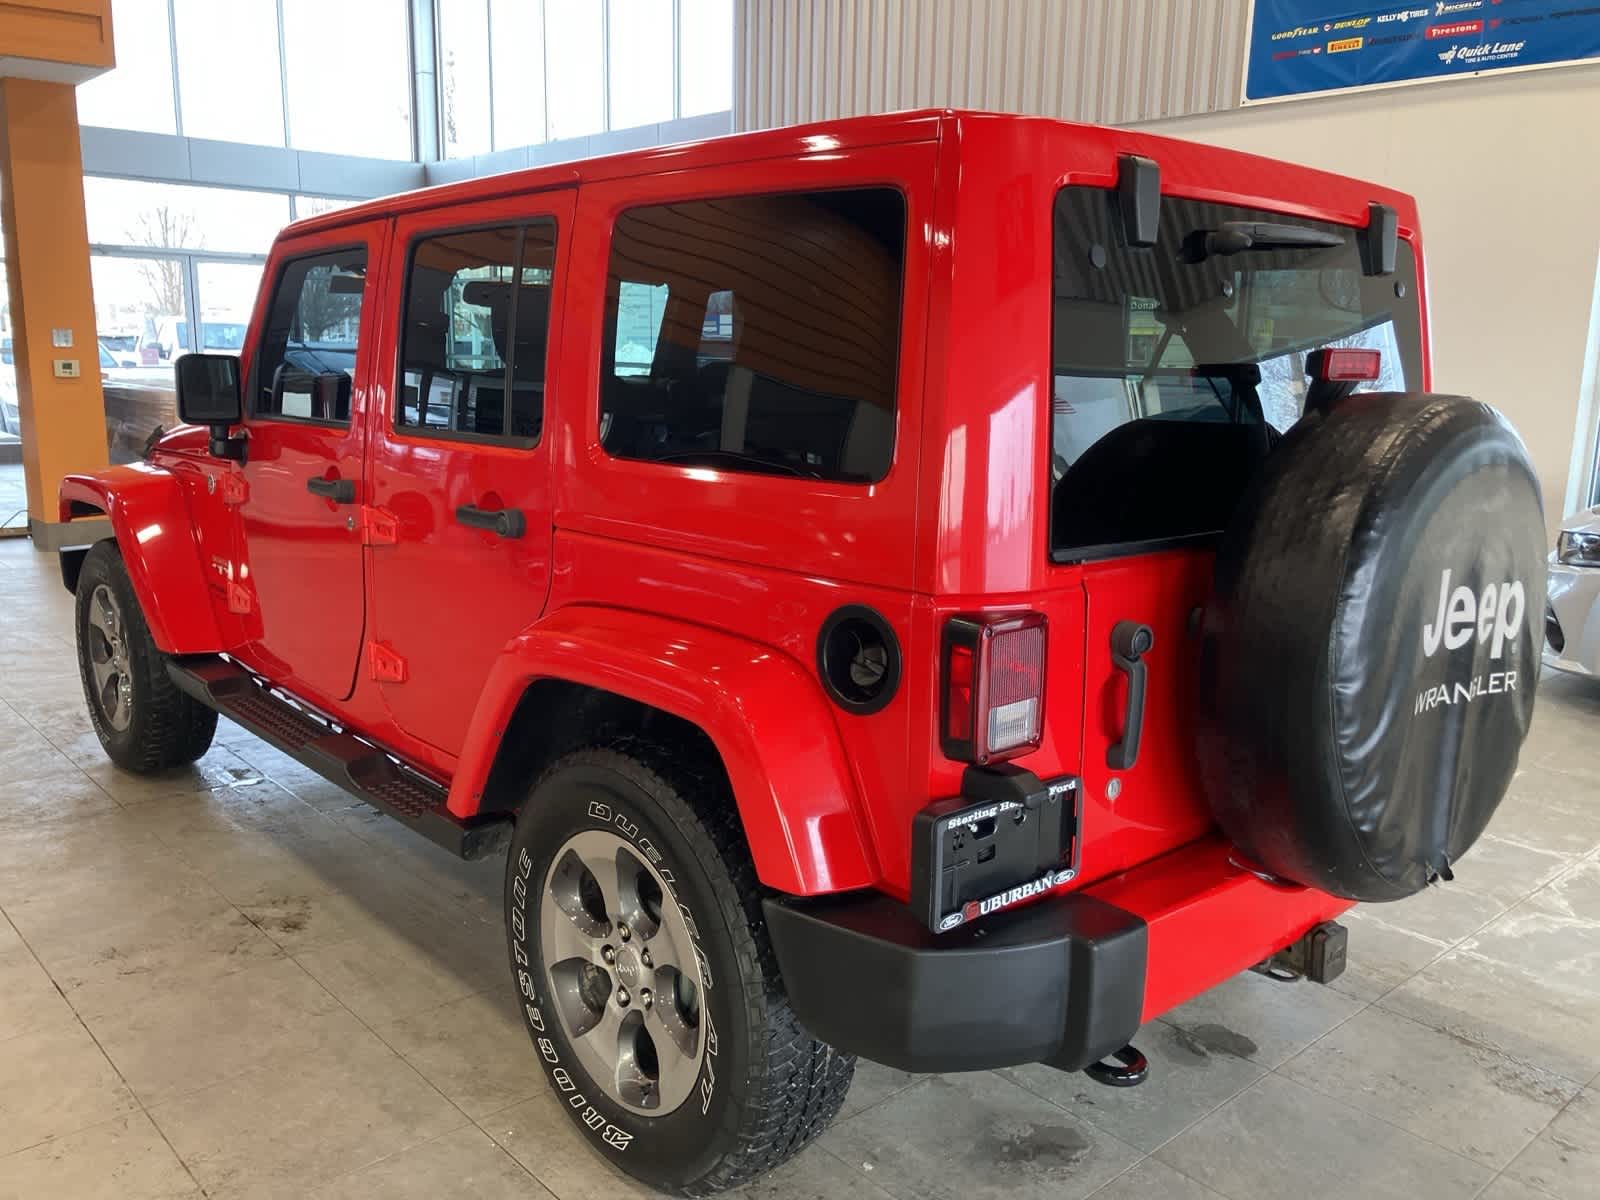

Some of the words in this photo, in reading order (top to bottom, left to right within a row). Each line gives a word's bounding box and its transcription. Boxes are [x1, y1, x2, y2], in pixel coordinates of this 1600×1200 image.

[1444, 1, 1482, 11] MICHELIN
[1333, 17, 1372, 30] DUNLOP
[1377, 13, 1397, 23] KELLY
[1271, 26, 1319, 41] GOODYEAR
[1432, 24, 1478, 37] Firestone
[1330, 40, 1360, 51] PIRELLI
[1457, 43, 1493, 59] Quick
[1492, 41, 1525, 54] Lane
[1480, 54, 1496, 62] AUTO
[1496, 51, 1518, 60] CENTER
[1423, 568, 1525, 660] Jeep
[1049, 780, 1076, 796] Ford
[513, 848, 634, 1152] BRIDGESTONE
